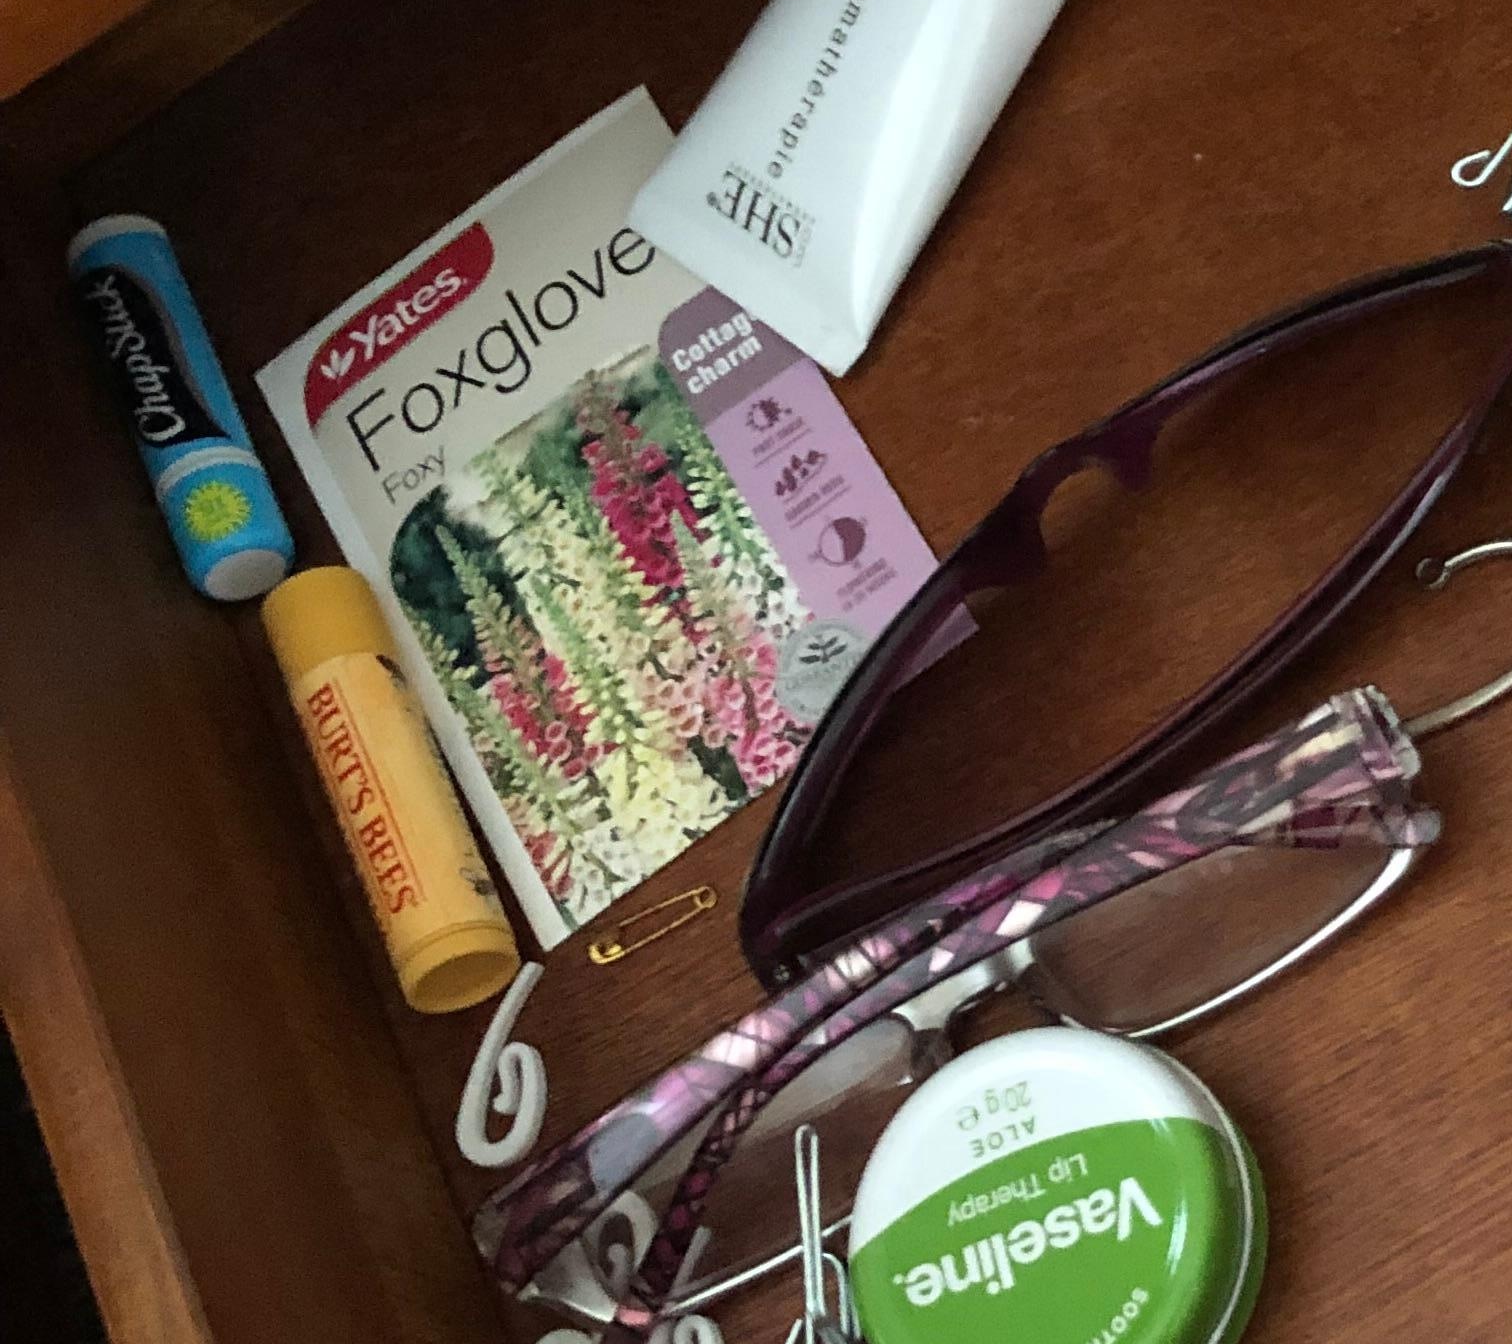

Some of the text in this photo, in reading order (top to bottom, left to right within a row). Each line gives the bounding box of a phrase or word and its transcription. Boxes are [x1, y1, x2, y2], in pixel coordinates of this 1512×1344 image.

[346, 227, 657, 472] Foxglove
[349, 267, 463, 361] Yates
[671, 312, 755, 372] Cottag
[86, 273, 186, 442] ChapStick
[686, 336, 762, 394] charm
[381, 445, 444, 505] Foxy
[306, 682, 420, 915] BURT'S BEES
[969, 1115, 1037, 1158] ALOE
[947, 1152, 1090, 1227] Lip Therapy
[900, 1176, 1163, 1307] Vaseline
